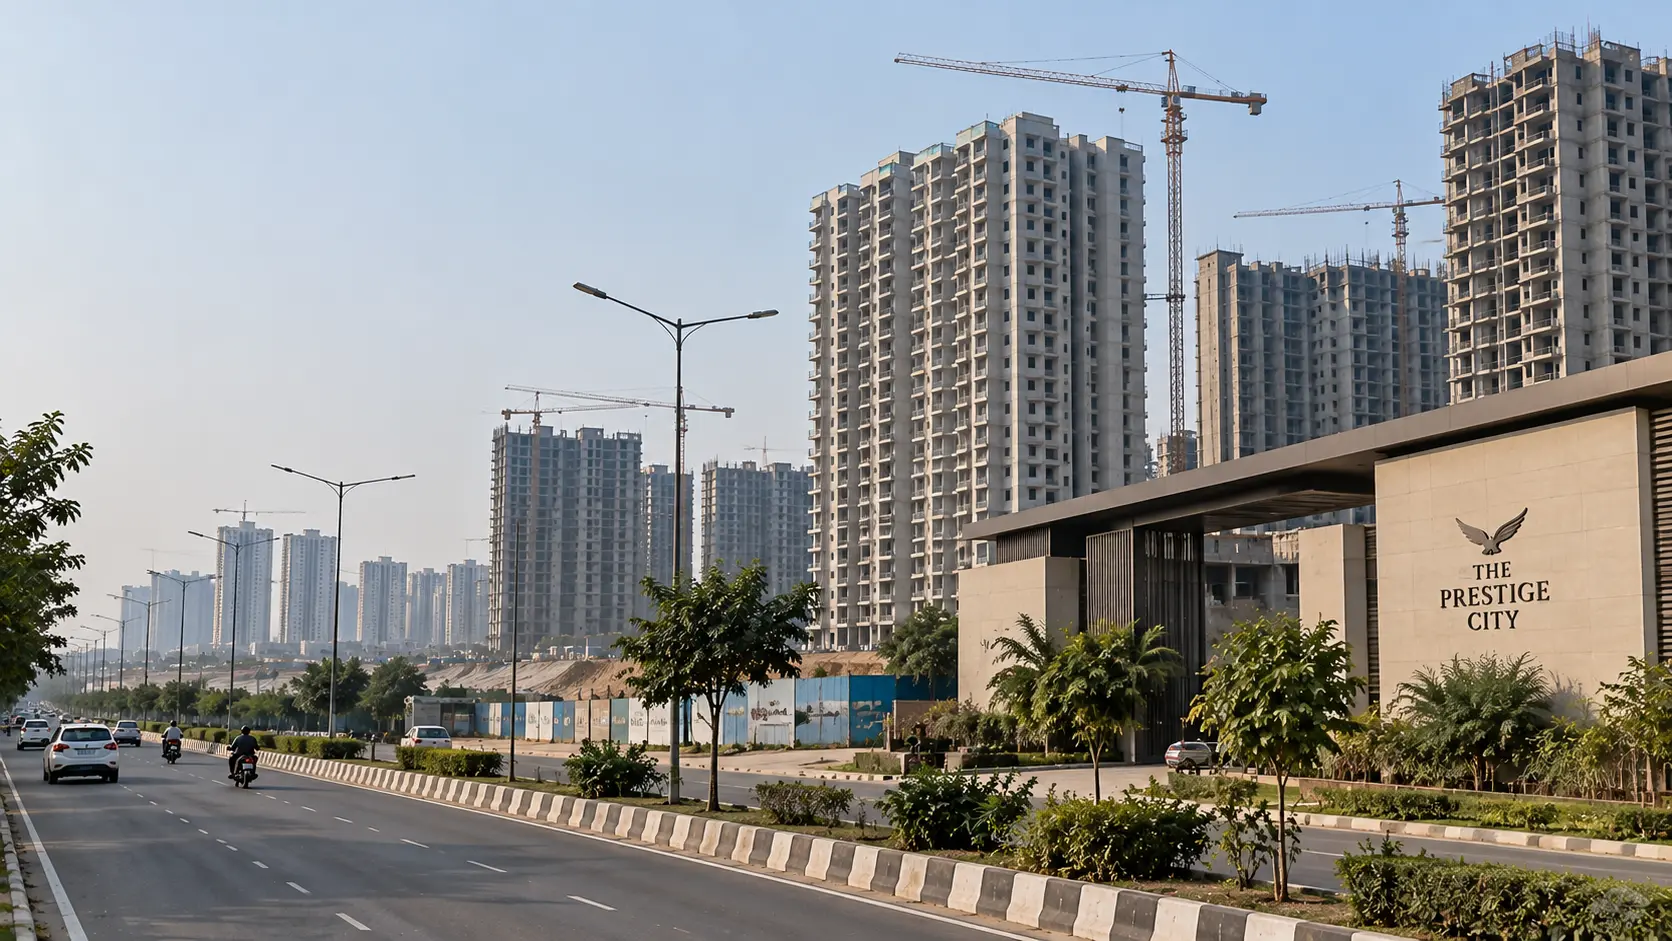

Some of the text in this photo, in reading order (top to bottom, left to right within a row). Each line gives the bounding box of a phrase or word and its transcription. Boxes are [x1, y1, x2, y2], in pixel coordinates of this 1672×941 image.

[1472, 561, 1511, 580] THE
[1440, 580, 1550, 609] PRESTIGE
[1467, 610, 1519, 631] CITY
